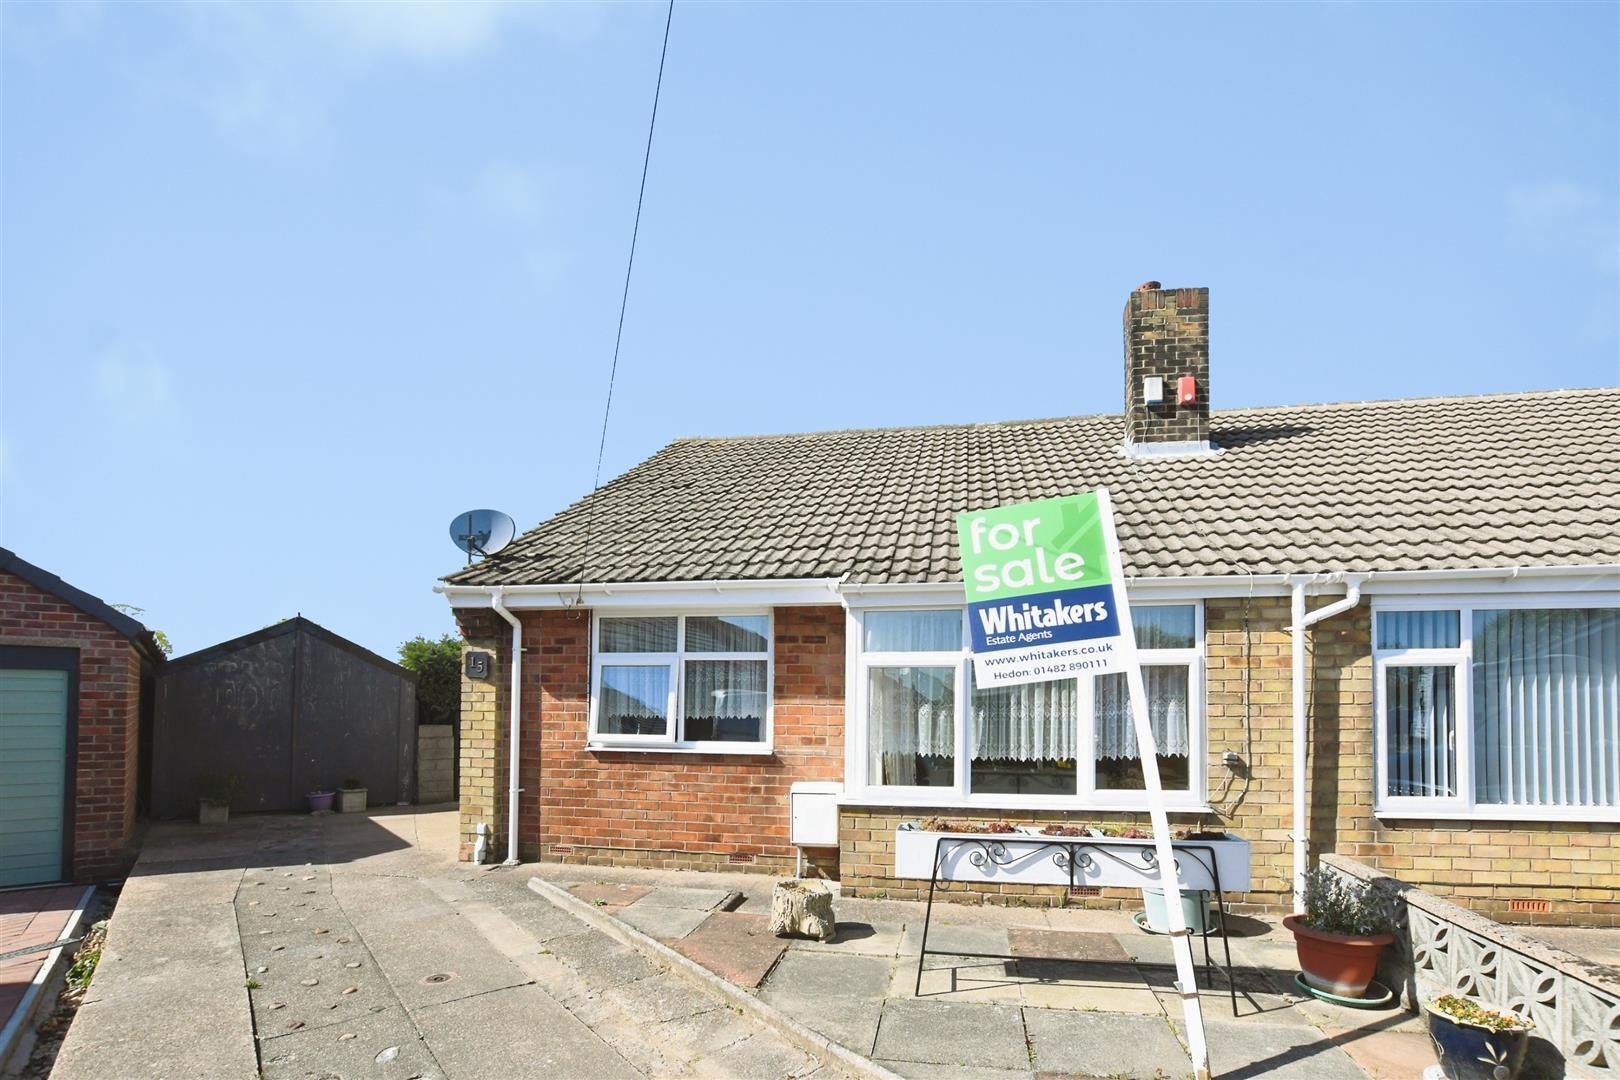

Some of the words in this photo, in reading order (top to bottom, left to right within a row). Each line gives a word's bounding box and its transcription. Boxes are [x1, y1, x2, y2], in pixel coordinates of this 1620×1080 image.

[970, 517, 1040, 554] for
[974, 546, 1085, 592] sale
[979, 598, 1108, 635] Whitakers
[986, 634, 1016, 646] Estate
[1018, 630, 1053, 642] Agents
[470, 656, 484, 673] 15
[984, 643, 1113, 666] www.whitakers.co.uk
[1034, 664, 1067, 676] 01482
[1069, 659, 1108, 672] 890111
